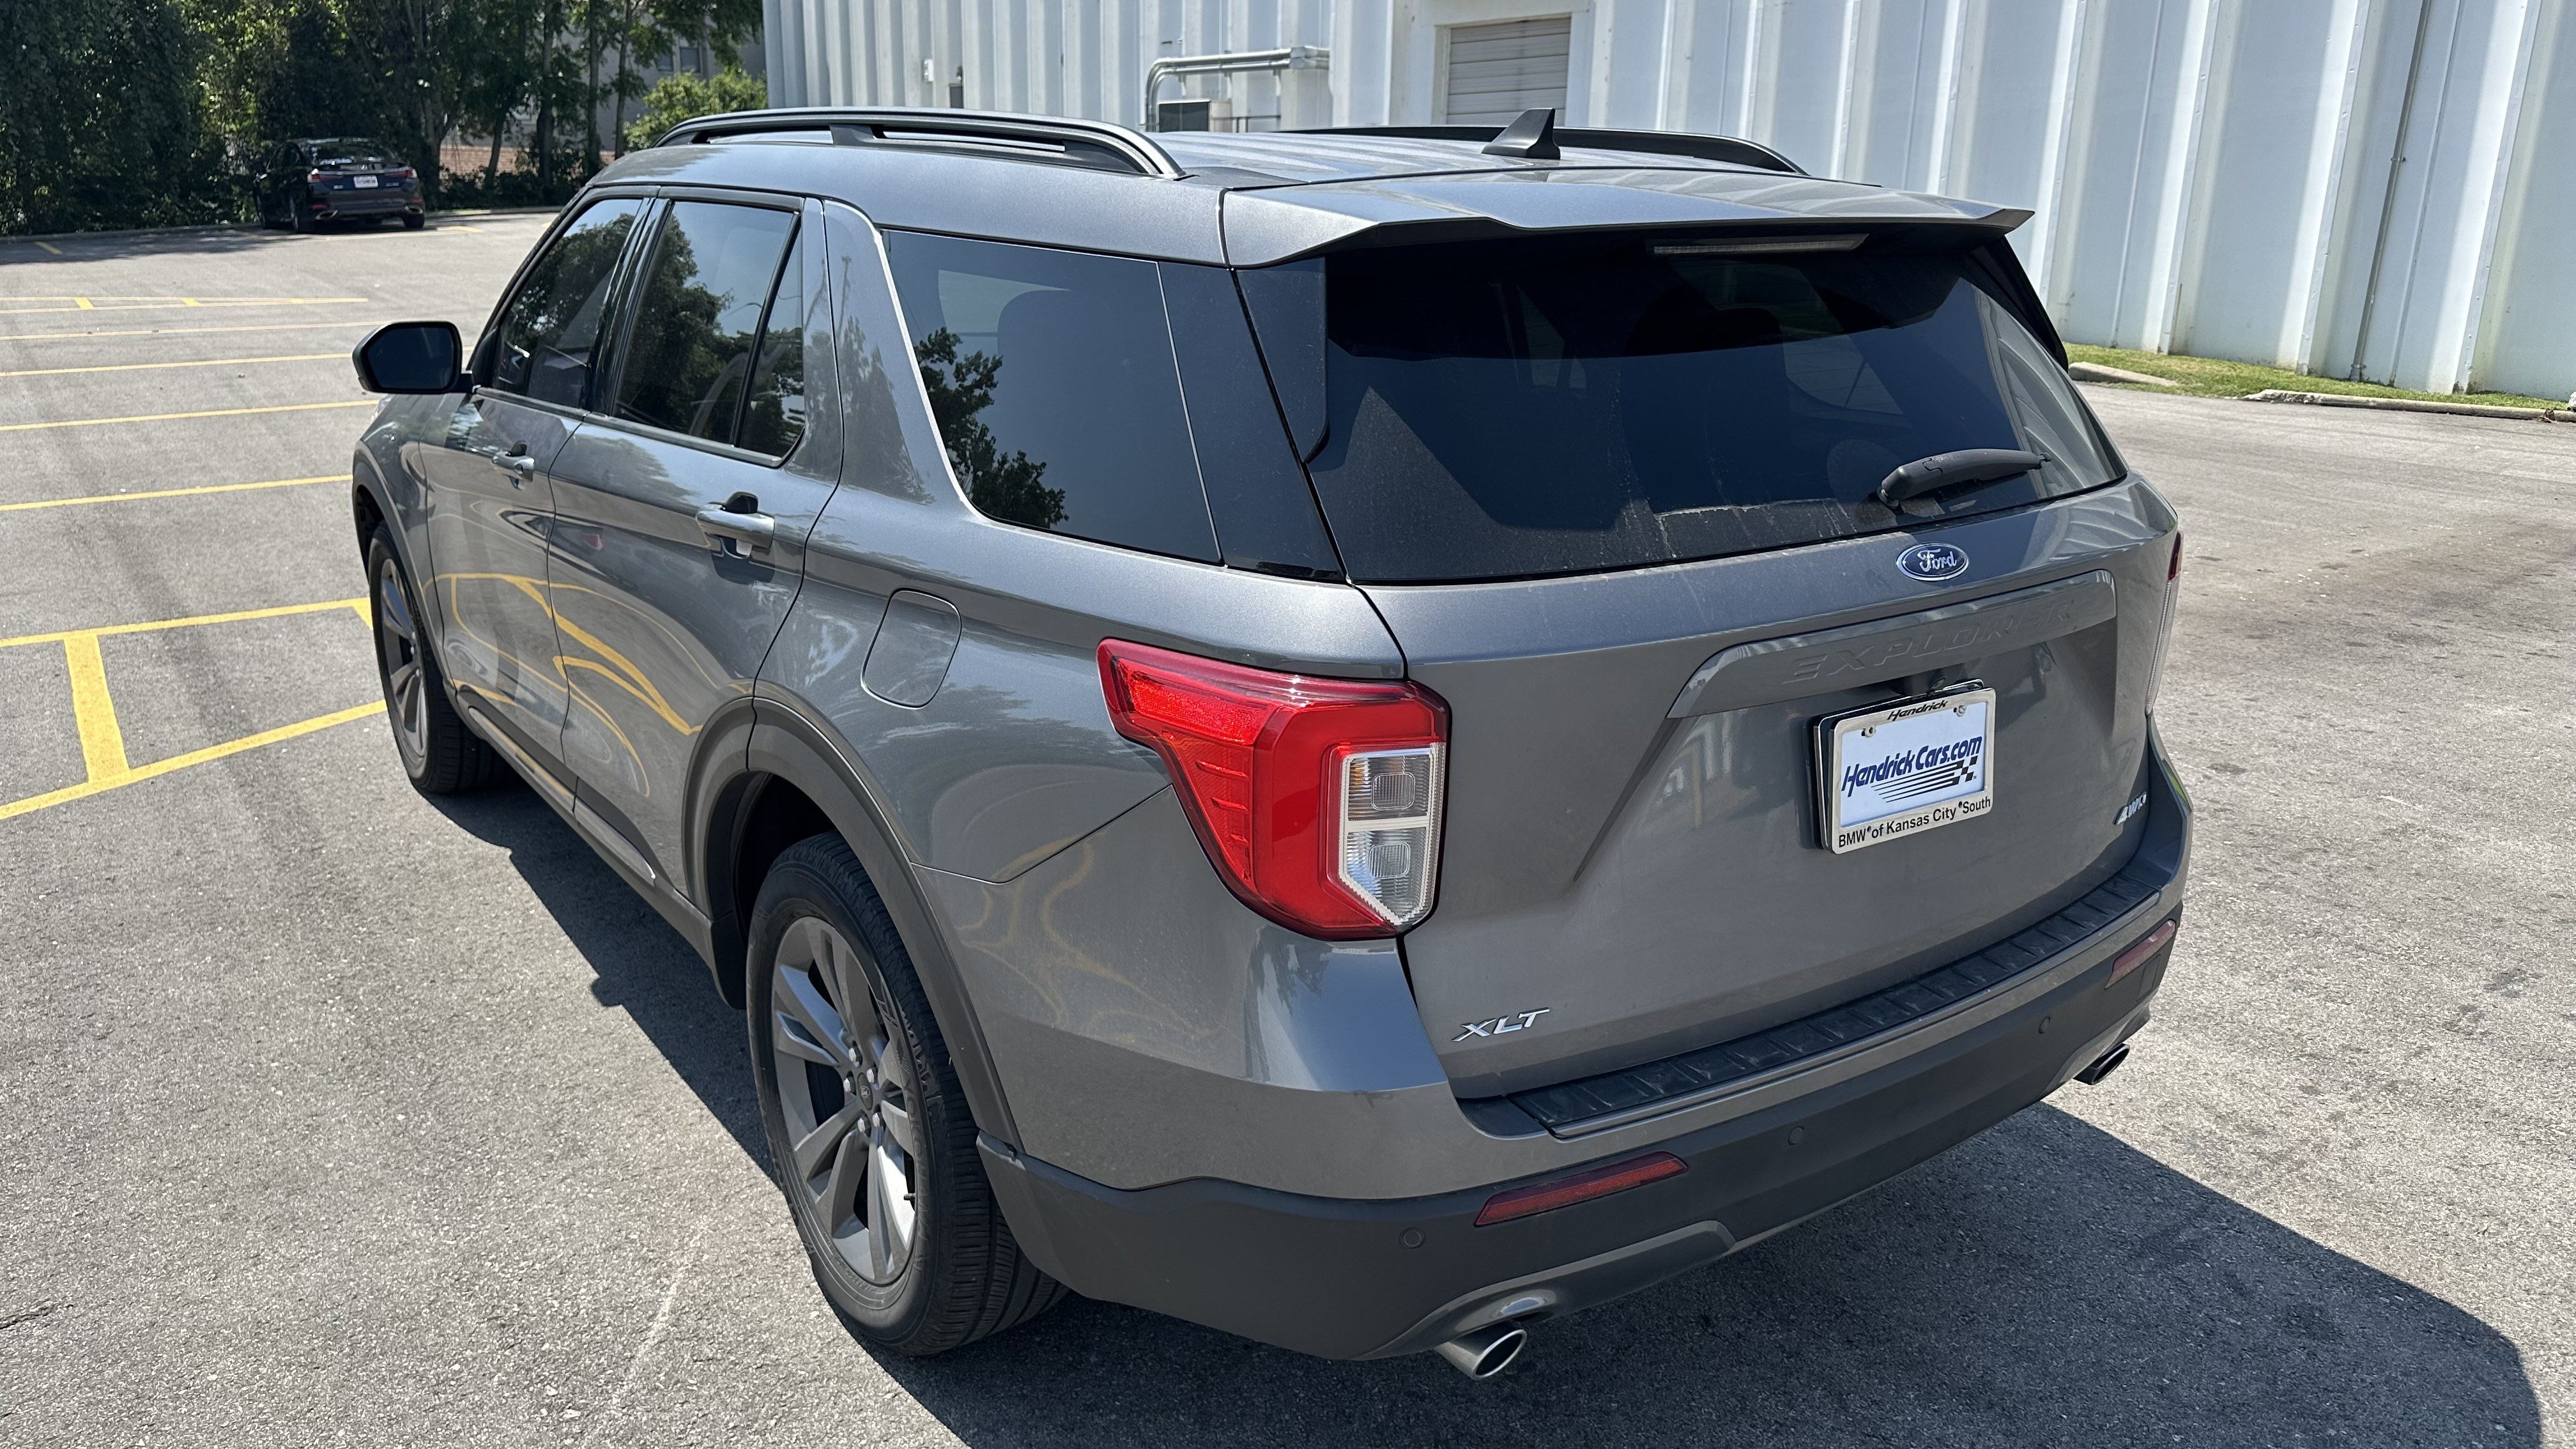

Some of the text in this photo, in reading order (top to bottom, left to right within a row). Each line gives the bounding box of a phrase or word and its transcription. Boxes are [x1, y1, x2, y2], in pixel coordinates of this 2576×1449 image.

[1917, 549, 1957, 572] Ford
[1887, 700, 1948, 721] Hendrick
[1839, 796, 1991, 848] BMW of Kansas City South
[1451, 1007, 1550, 1042] XLT
